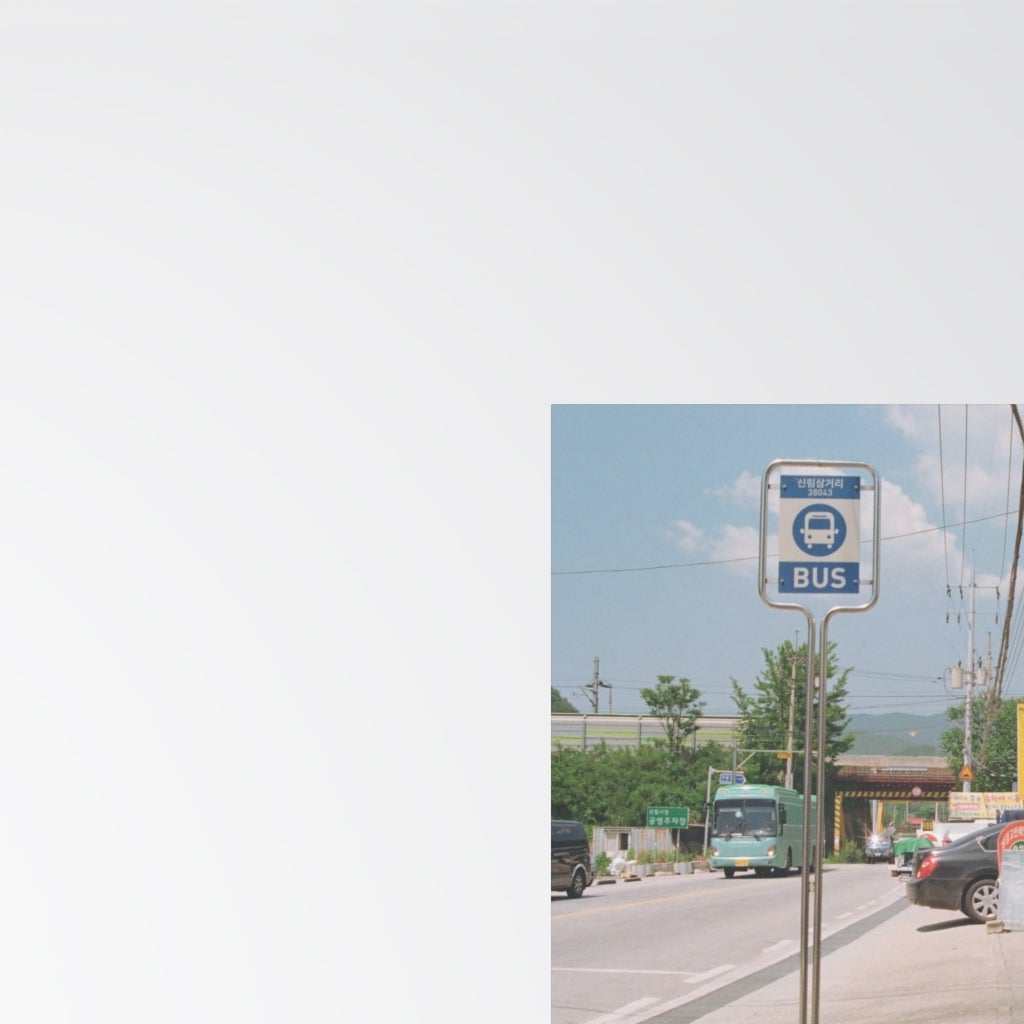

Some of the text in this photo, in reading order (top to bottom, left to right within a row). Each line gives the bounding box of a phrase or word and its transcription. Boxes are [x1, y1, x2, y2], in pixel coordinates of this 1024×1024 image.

[797, 478, 844, 489] 신림삼거리
[808, 489, 833, 497] 38043
[793, 567, 847, 588] BUS
